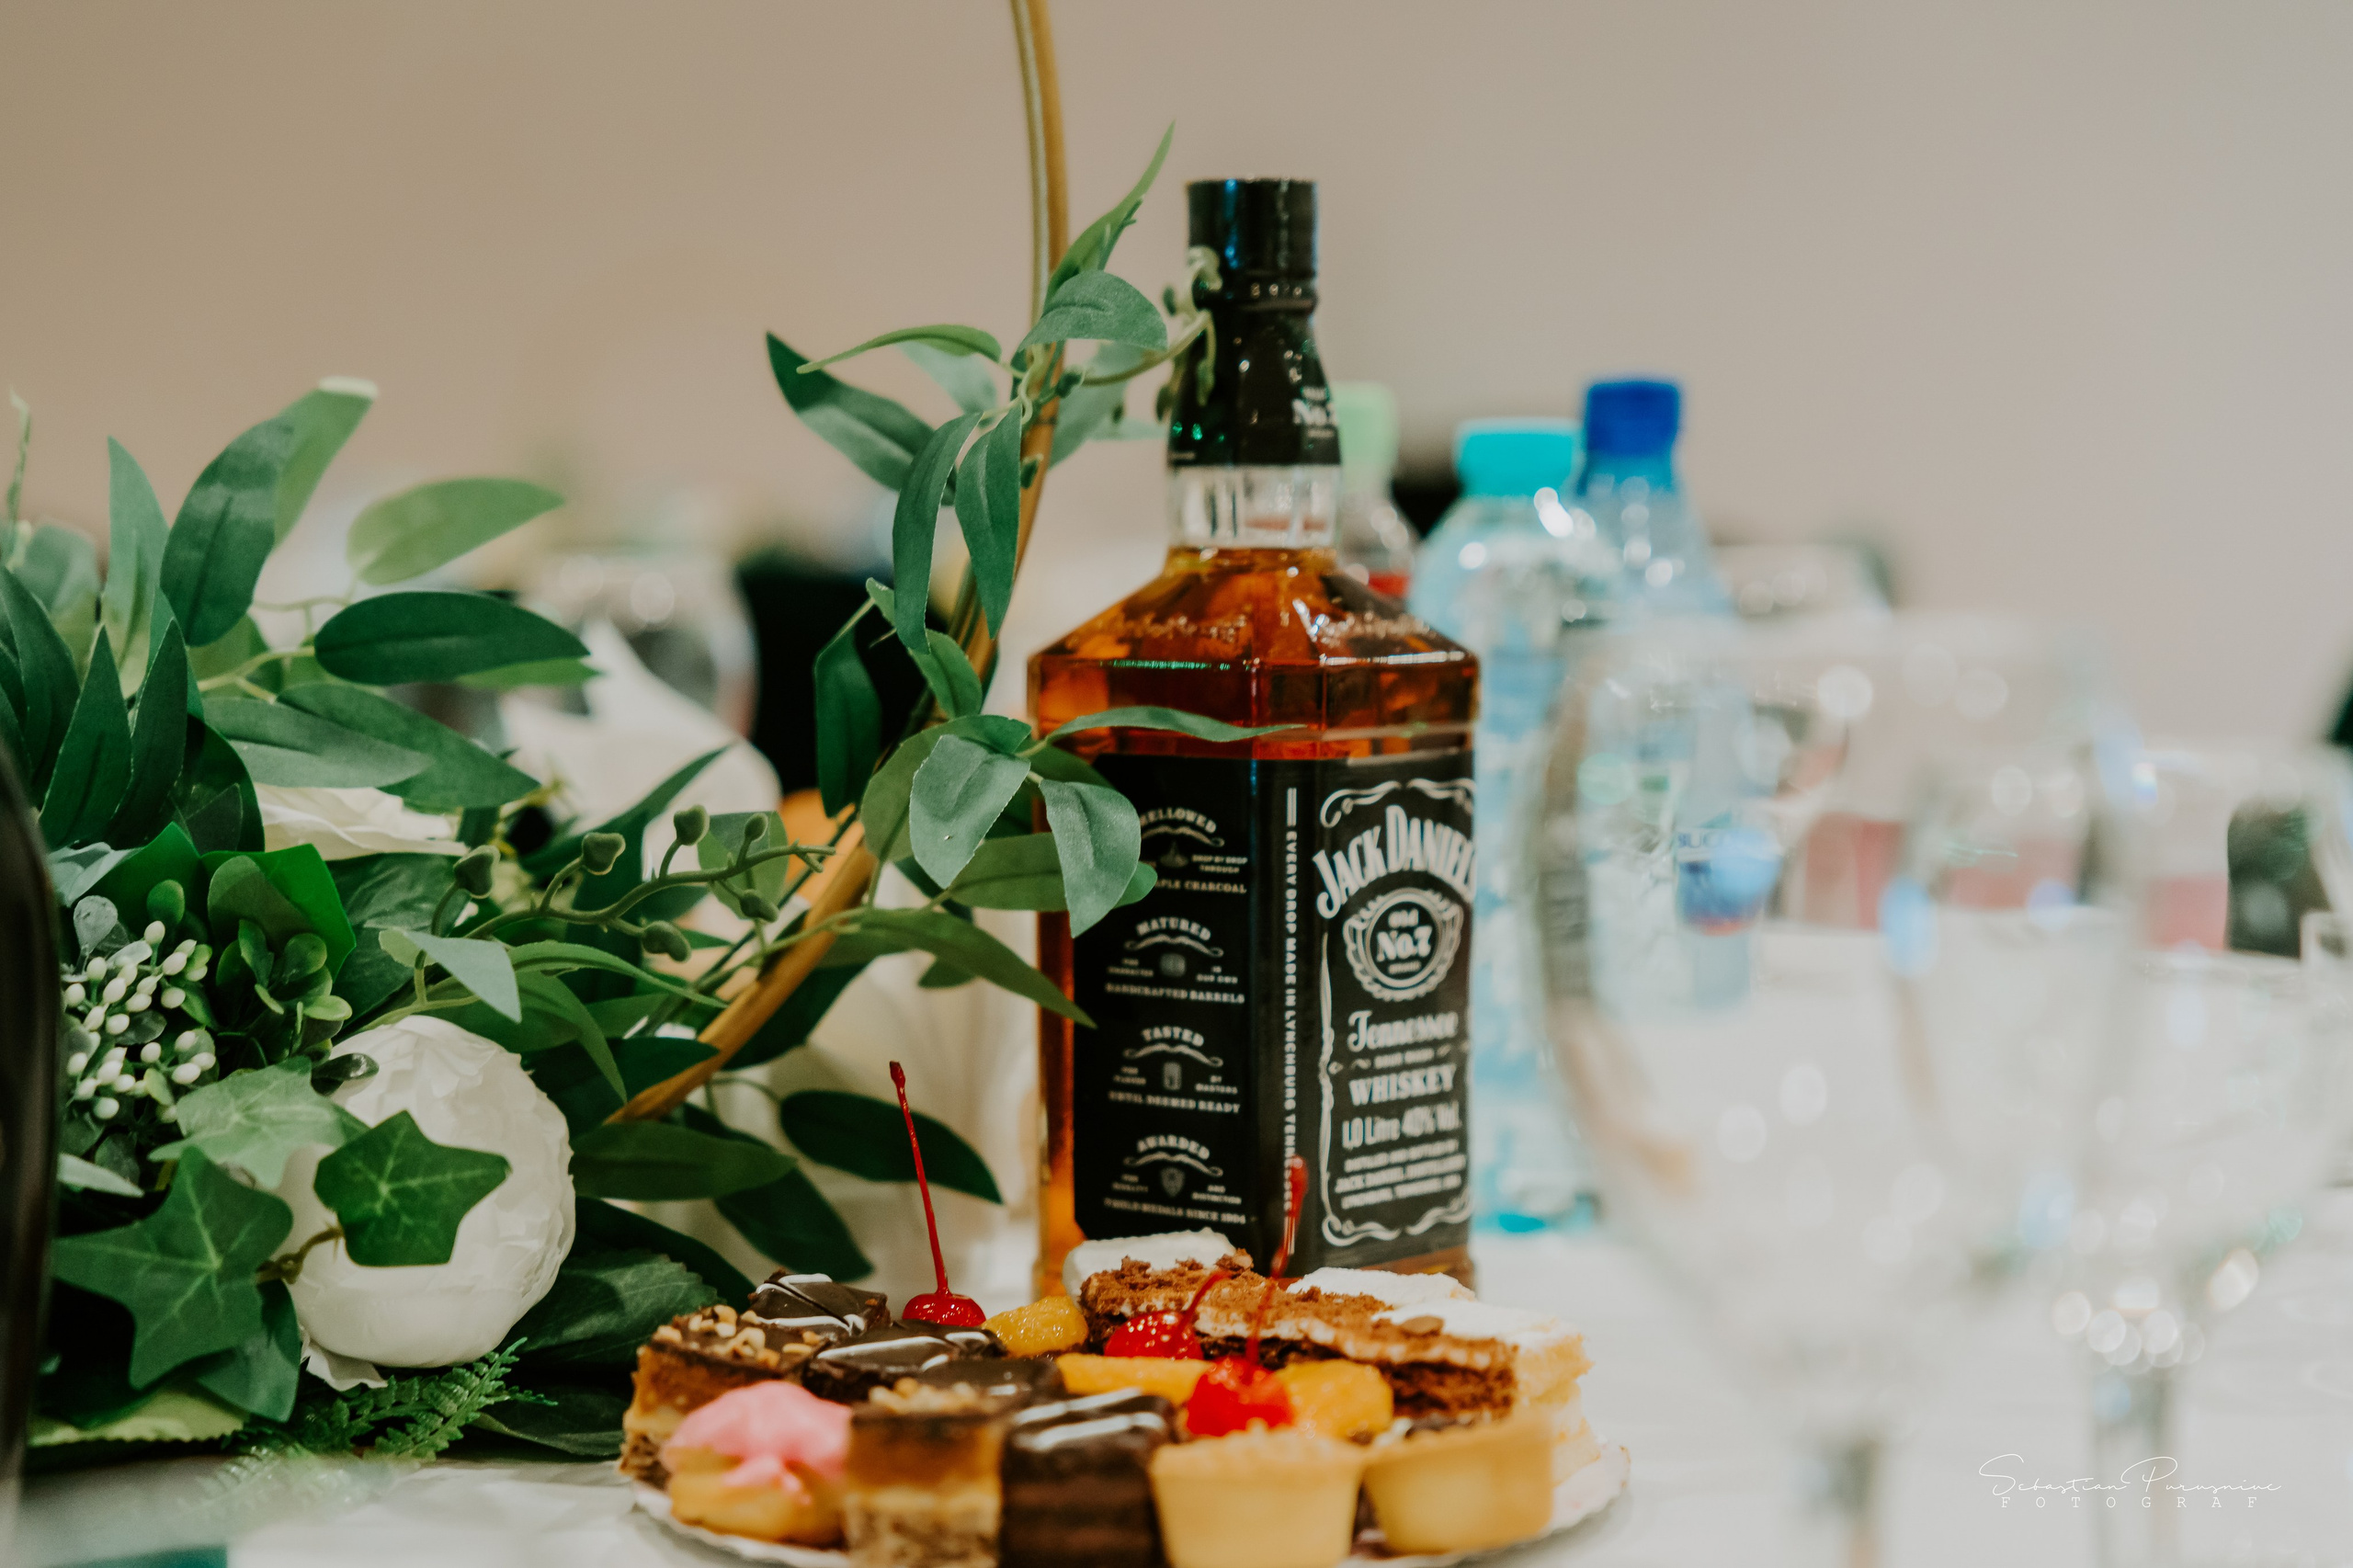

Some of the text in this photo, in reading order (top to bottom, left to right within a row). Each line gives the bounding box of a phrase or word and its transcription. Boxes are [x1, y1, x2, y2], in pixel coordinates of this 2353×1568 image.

[1285, 831, 1297, 886] EVERY
[1312, 825, 1387, 919] JACK
[1136, 916, 1211, 941] MATURED
[1285, 888, 1297, 934] DROP
[1285, 937, 1296, 985] MADE
[1285, 989, 1296, 1006] IN
[1142, 1026, 1204, 1047] TASTED
[1348, 1062, 1457, 1106] WHISKEY
[1137, 1134, 1211, 1160] AWARDED
